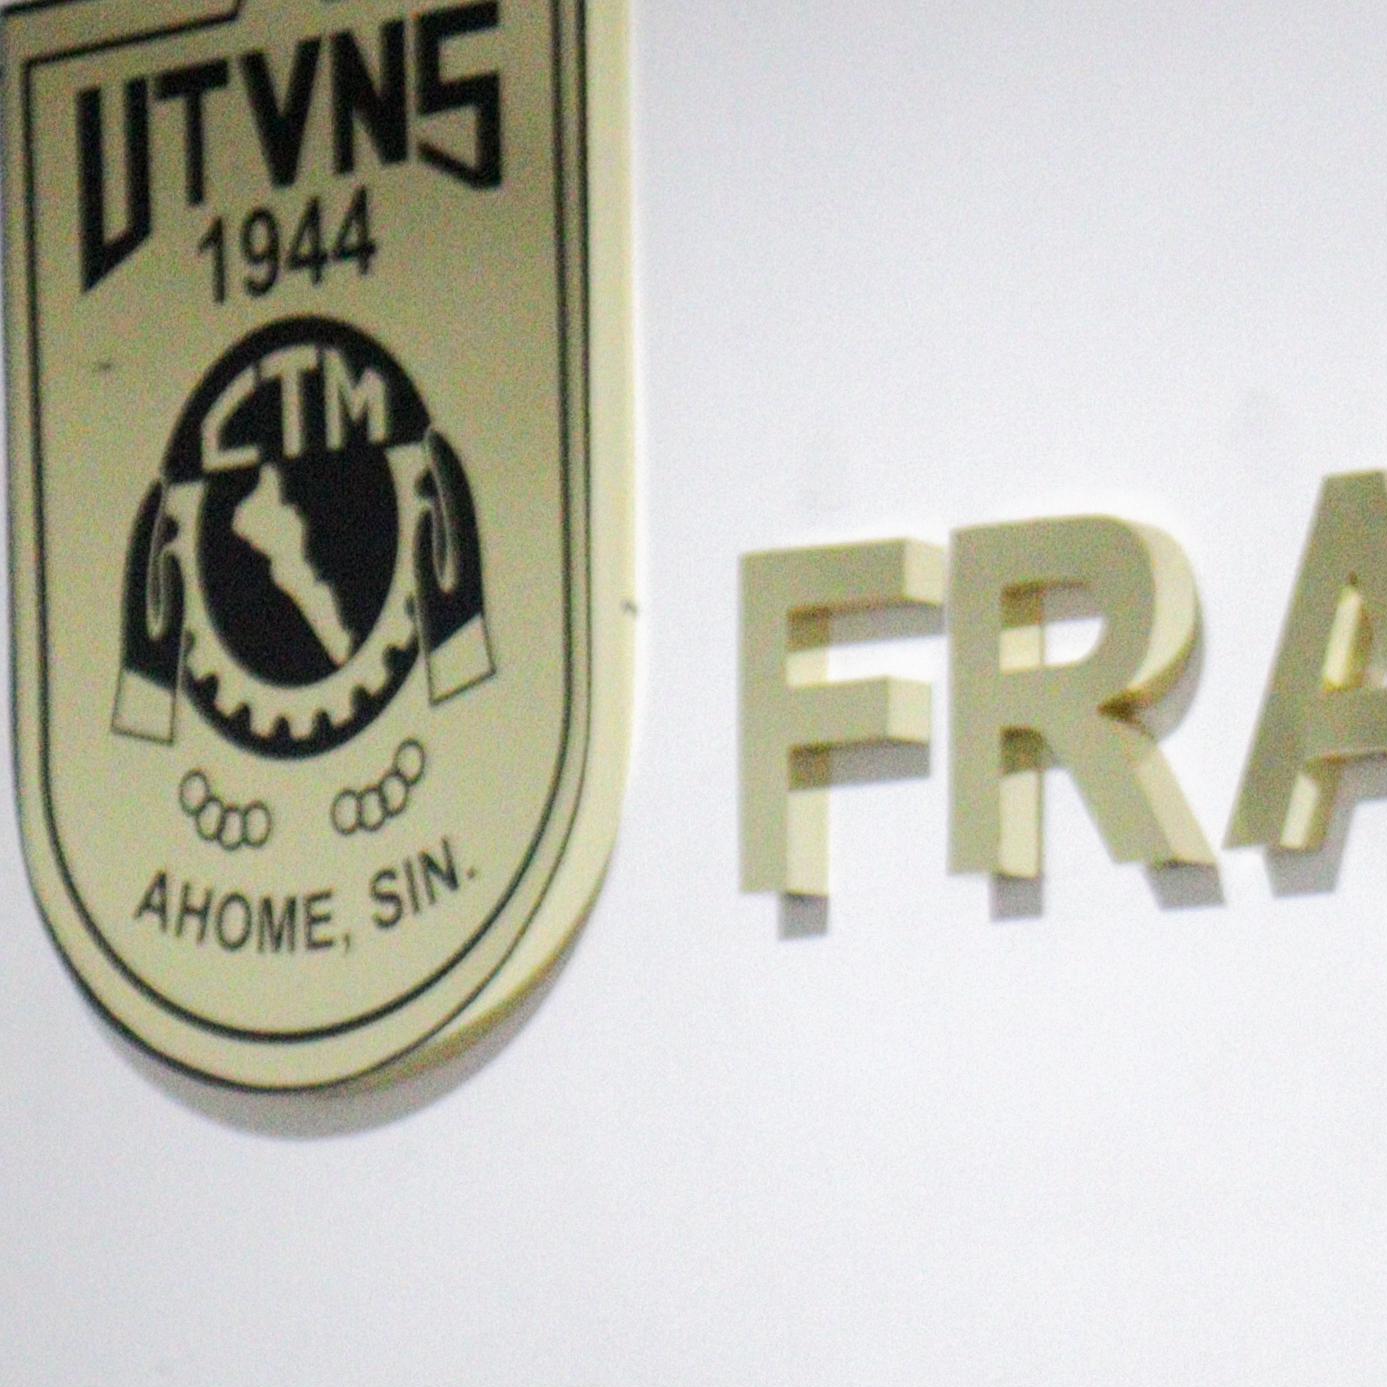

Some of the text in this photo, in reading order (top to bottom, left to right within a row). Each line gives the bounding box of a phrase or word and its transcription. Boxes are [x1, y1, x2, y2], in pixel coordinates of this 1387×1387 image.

[200, 186, 378, 302] 1944
[201, 343, 388, 471] CTM
[134, 836, 479, 955] AHOME, SIN.
